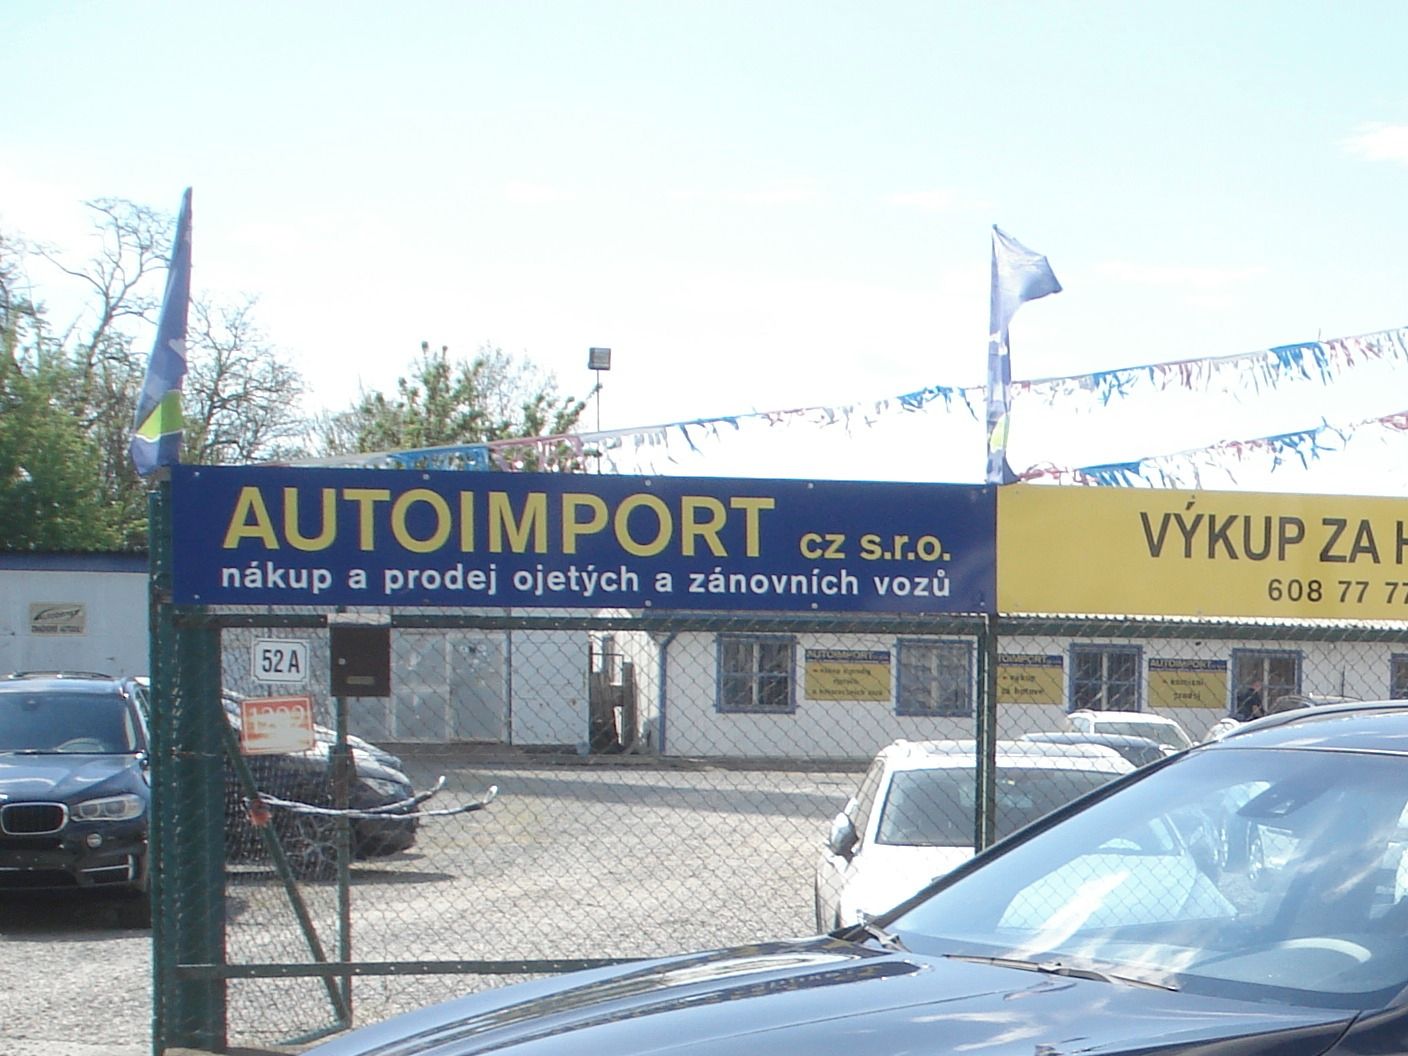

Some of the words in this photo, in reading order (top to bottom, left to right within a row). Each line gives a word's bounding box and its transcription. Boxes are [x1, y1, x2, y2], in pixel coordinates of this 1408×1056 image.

[223, 486, 776, 558] AUTOIMPORT
[799, 533, 846, 560] cz
[859, 533, 951, 562] s.r.o.
[1140, 500, 1306, 562] VÝKUP
[1319, 517, 1382, 565] ZA
[221, 561, 332, 595] nákup
[348, 567, 368, 591] a
[384, 563, 497, 595] prodej
[512, 565, 639, 598] ojetých
[655, 570, 673, 593] a
[688, 566, 859, 596] zánovních
[873, 568, 951, 597] vozů
[1267, 578, 1323, 603] 608
[1337, 580, 1370, 604] 77
